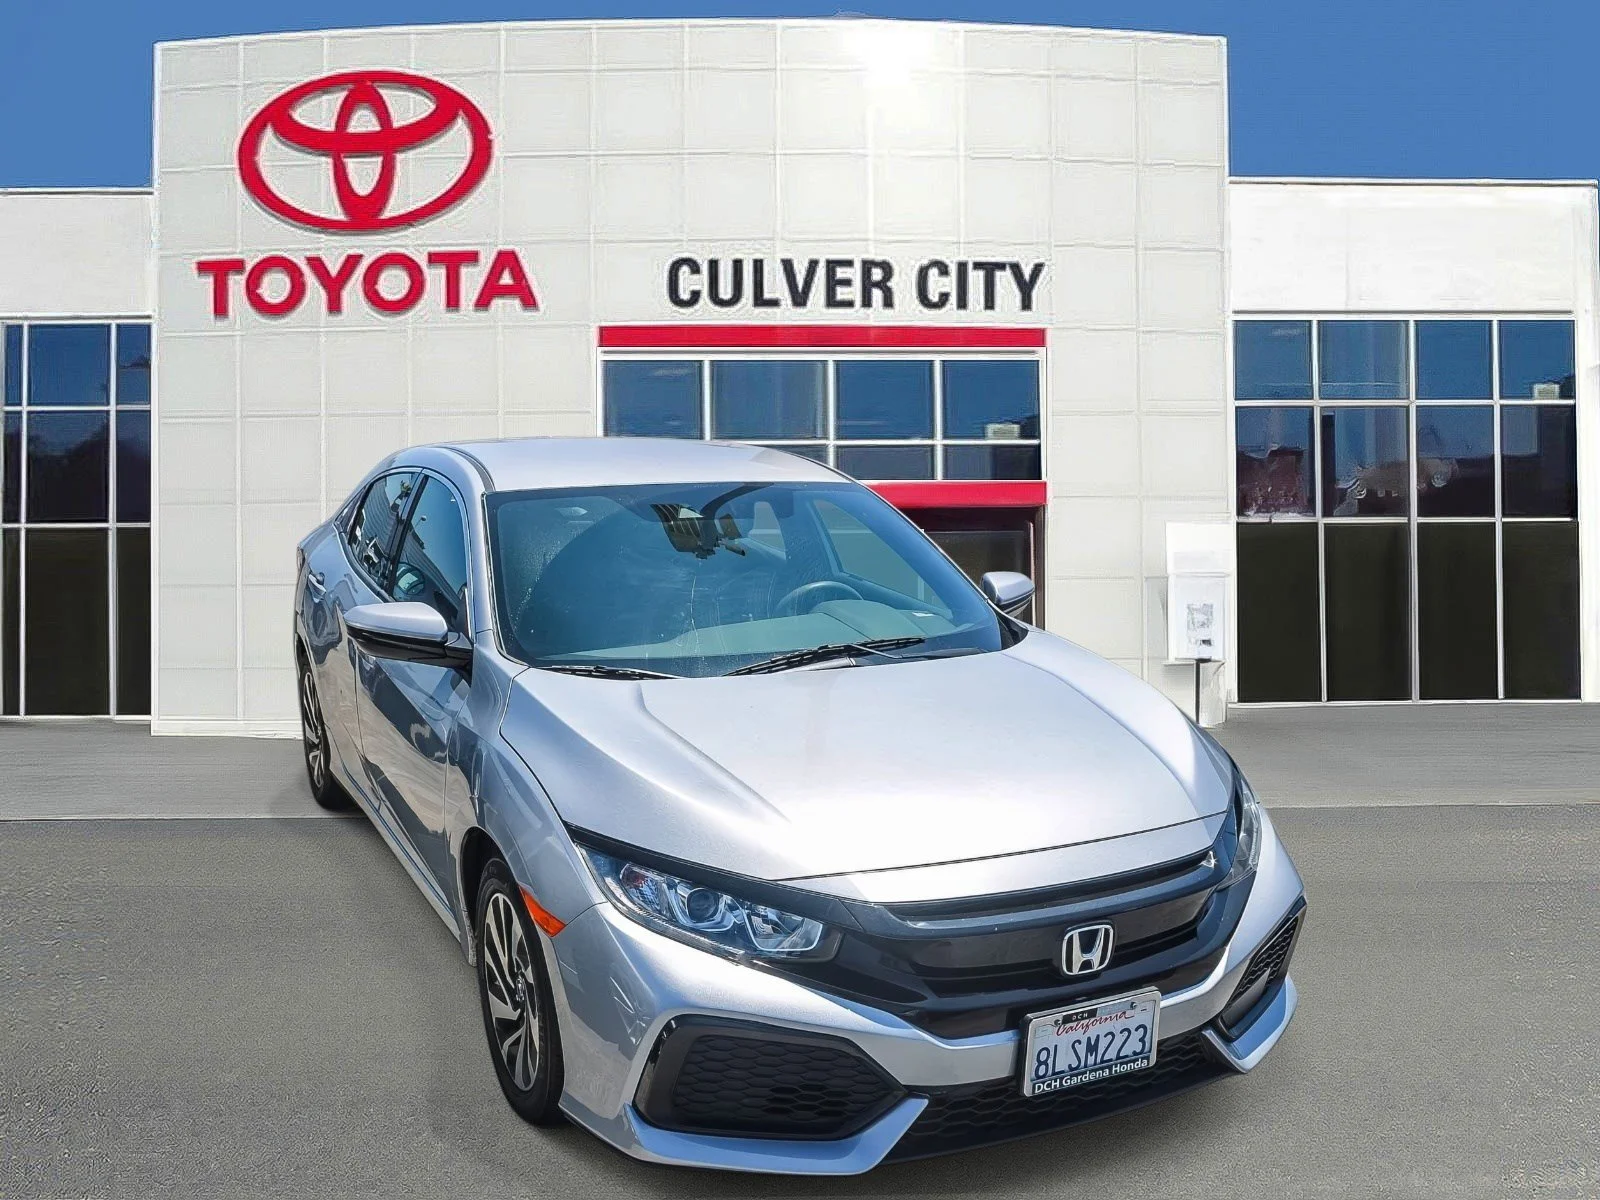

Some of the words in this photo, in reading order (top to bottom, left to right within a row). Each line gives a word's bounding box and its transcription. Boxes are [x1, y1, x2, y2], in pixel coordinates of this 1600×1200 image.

[196, 250, 539, 319] TOYOTA
[668, 258, 895, 309] CULVER
[916, 258, 1045, 311] CITY
[1055, 1010, 1135, 1036] California
[1072, 1012, 1088, 1021] DCH
[1034, 1023, 1148, 1079] 8LSM223
[1035, 1078, 1060, 1093] DCH
[1062, 1069, 1109, 1085] Gardena
[1112, 1058, 1148, 1075] Honda
